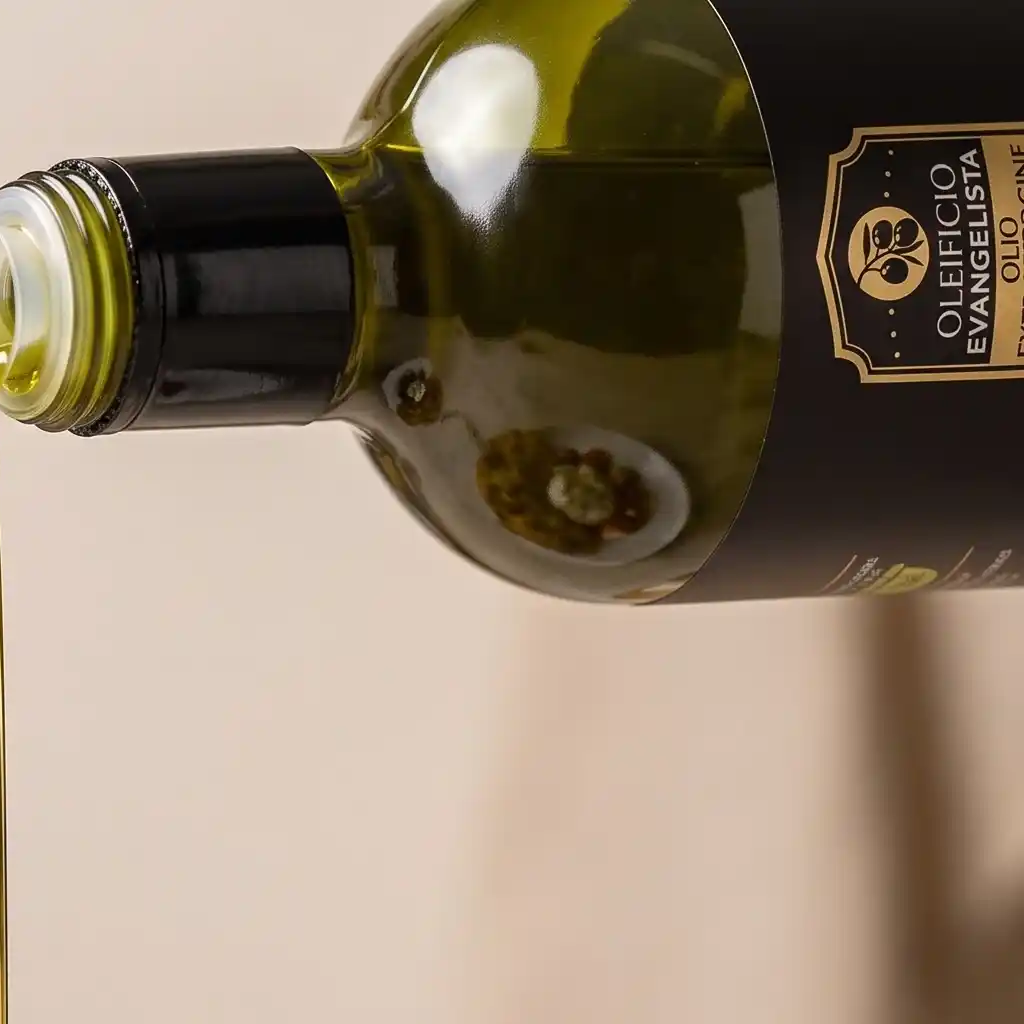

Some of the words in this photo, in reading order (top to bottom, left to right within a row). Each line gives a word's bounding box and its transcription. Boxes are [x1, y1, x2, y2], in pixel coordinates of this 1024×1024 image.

[930, 163, 963, 338] OLEIFICIO
[959, 148, 990, 354] EVANGELISTA
[999, 216, 1020, 283] OLIO
